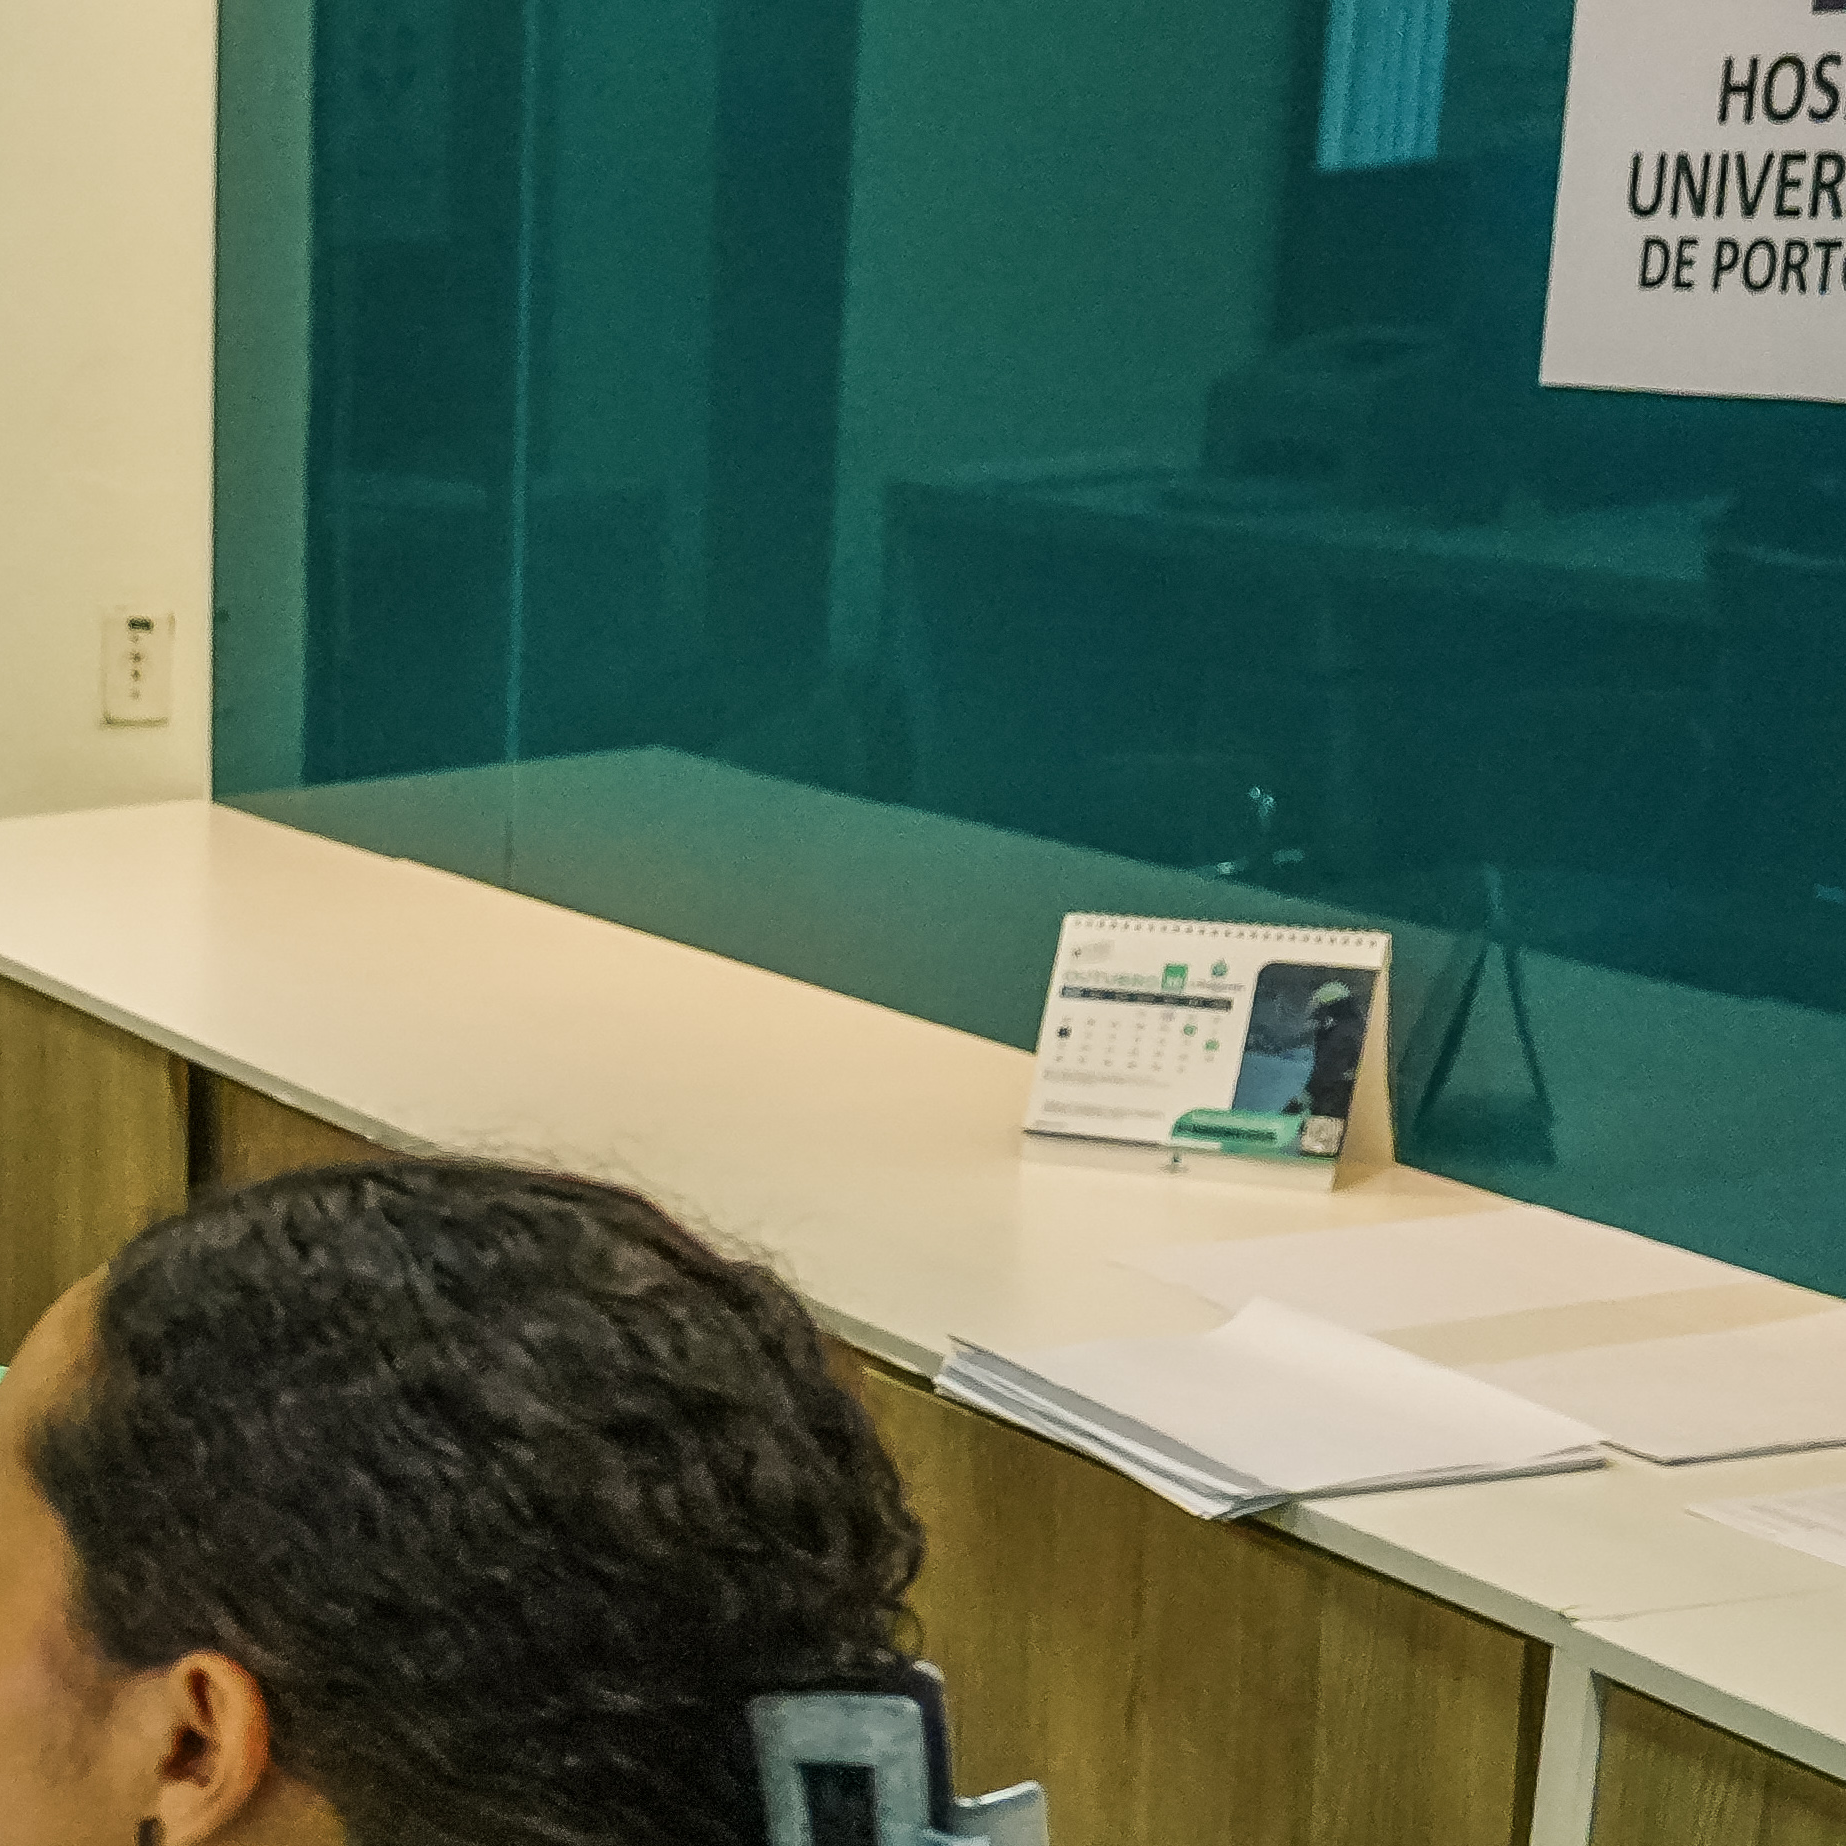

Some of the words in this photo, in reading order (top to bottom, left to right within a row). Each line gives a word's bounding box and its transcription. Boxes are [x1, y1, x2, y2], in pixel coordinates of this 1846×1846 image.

[1717, 53, 1844, 124] HOS
[1629, 150, 1846, 219] UNIVER
[1639, 237, 1699, 289] DE
[1711, 237, 1846, 294] PORT
